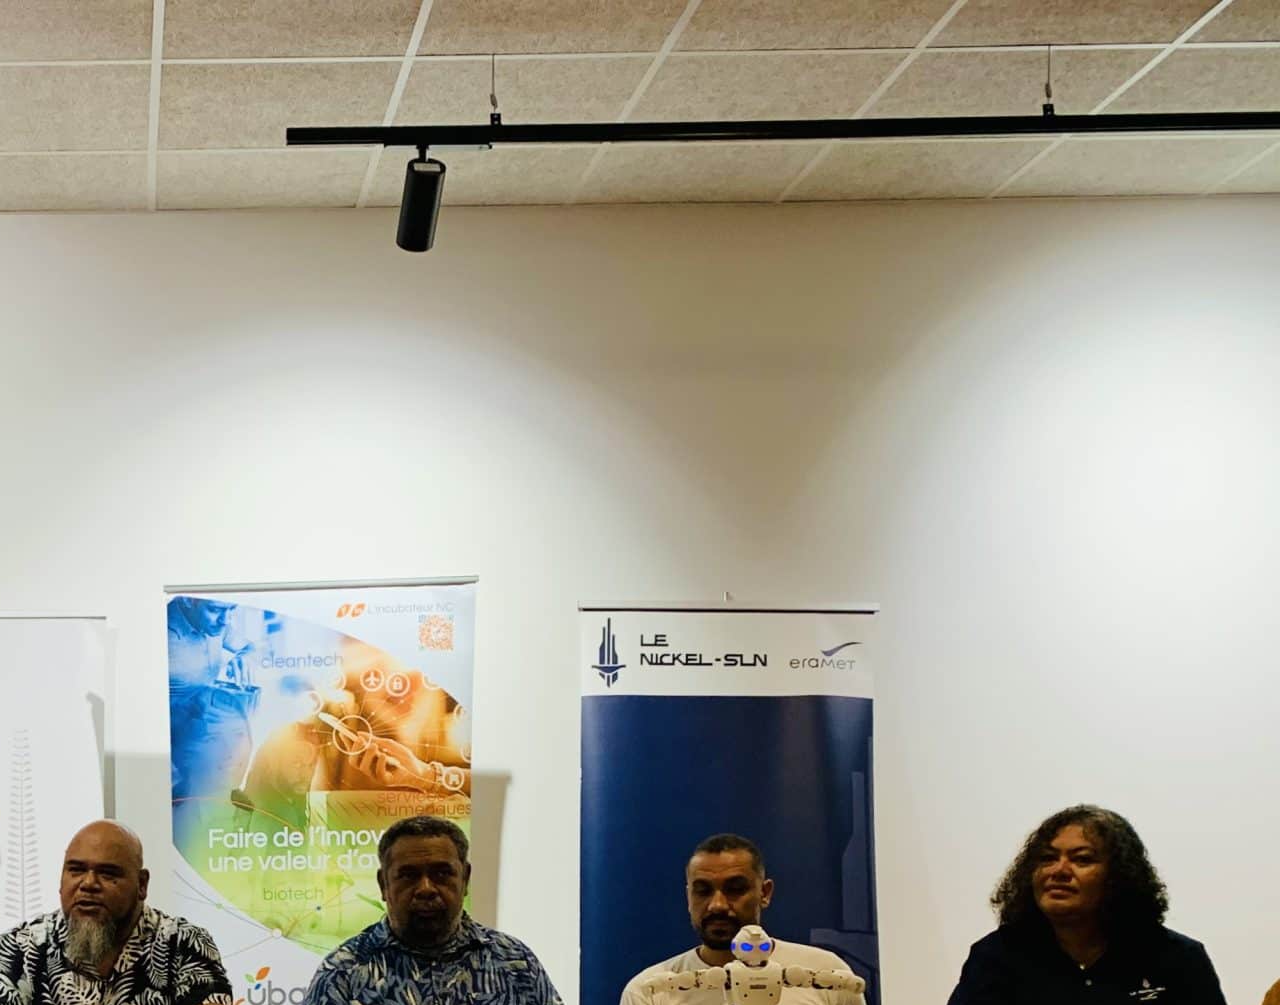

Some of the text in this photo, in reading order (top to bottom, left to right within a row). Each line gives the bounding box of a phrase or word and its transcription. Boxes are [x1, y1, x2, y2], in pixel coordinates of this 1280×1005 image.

[640, 634, 669, 647] LE
[261, 651, 345, 669] cleantech
[640, 653, 767, 667] NICKEL-SLN
[208, 827, 268, 849] Faire
[273, 826, 304, 848] de
[208, 848, 382, 873] une valeur d'av
[263, 885, 324, 901] biotech
